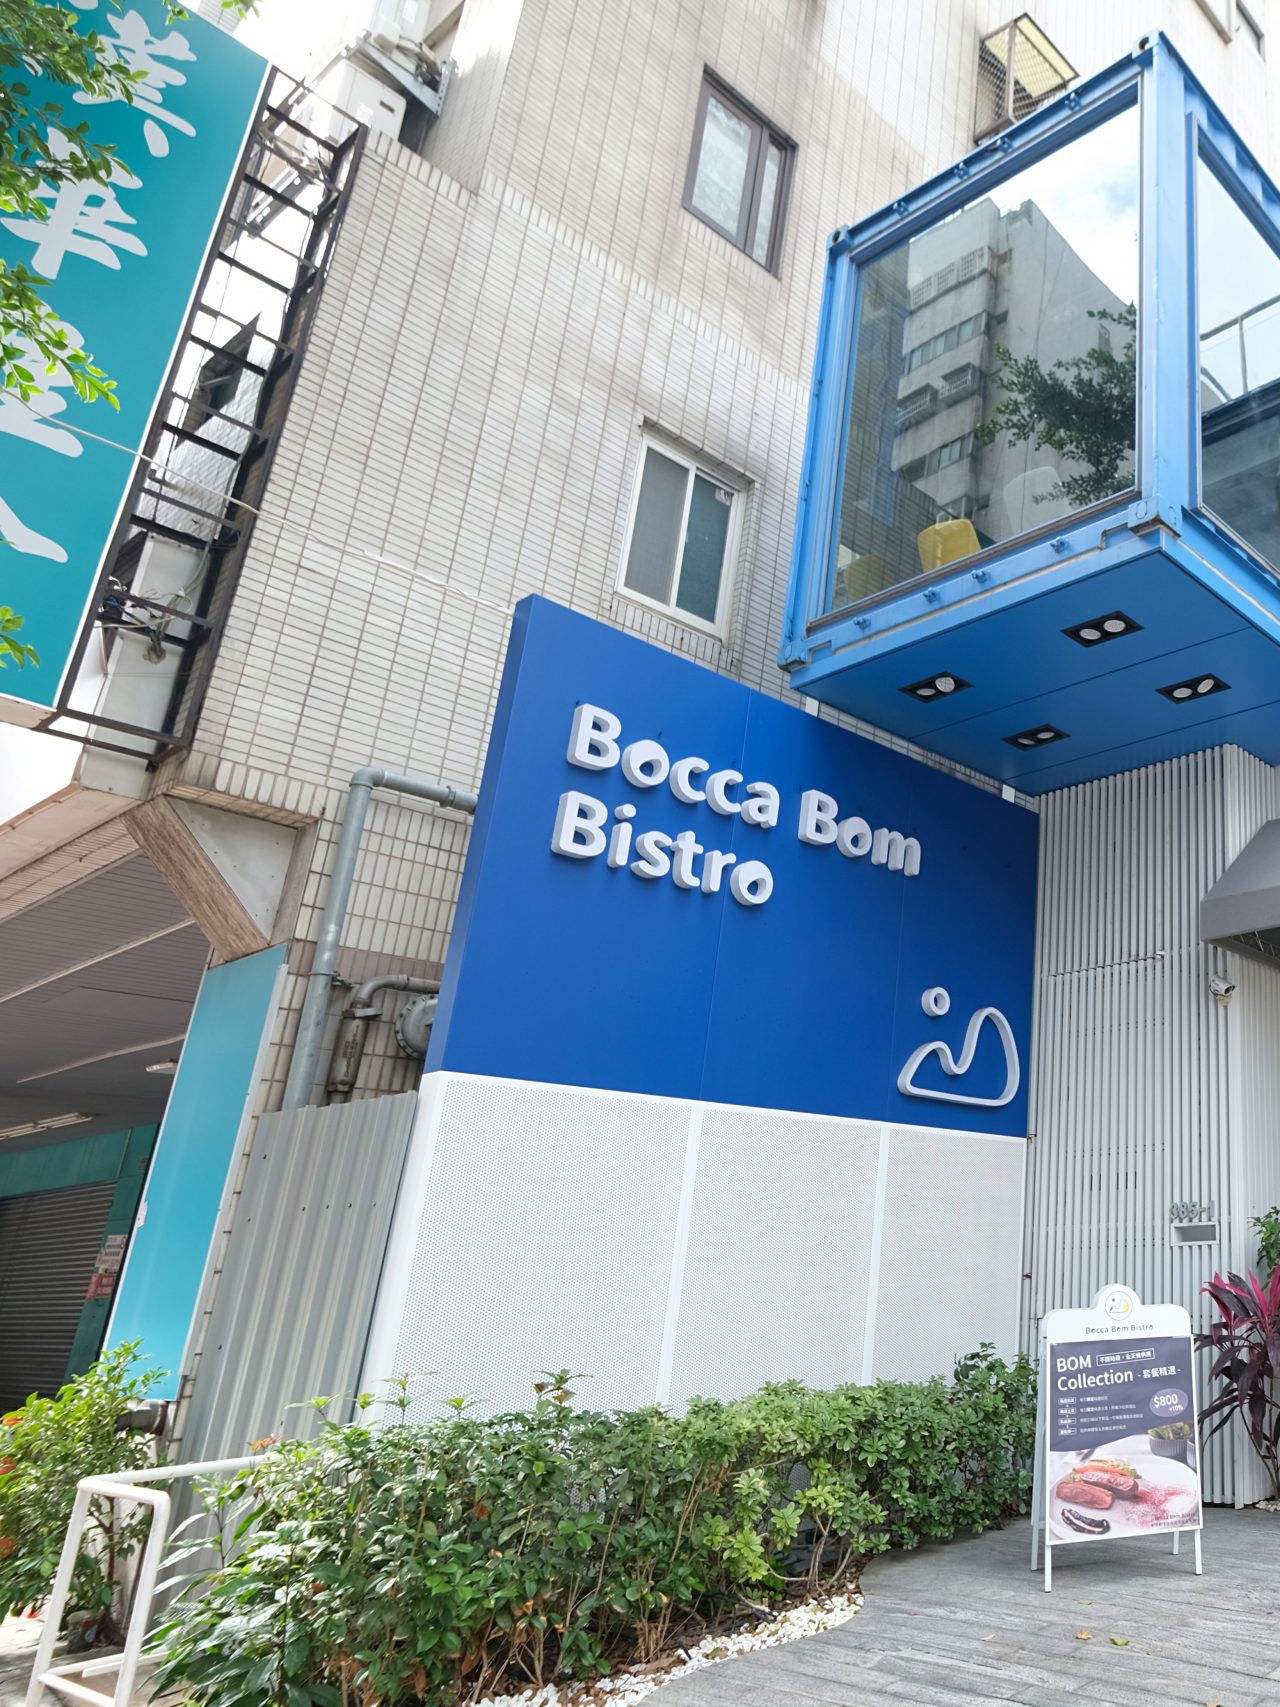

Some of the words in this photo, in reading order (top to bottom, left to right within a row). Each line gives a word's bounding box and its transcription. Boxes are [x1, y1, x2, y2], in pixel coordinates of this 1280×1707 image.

[567, 703, 780, 829] Bocca
[798, 789, 922, 877] Bom
[551, 790, 774, 906] Bistro
[1170, 1200, 1215, 1220] 385-1
[1086, 1327, 1109, 1335] Bocca
[1111, 1325, 1129, 1333] Bom
[1131, 1323, 1154, 1332] Bistro
[1056, 1355, 1092, 1373] BOM
[1057, 1369, 1134, 1391] Collection
[1153, 1393, 1178, 1408] $800
[1168, 1404, 1184, 1412] +10%
